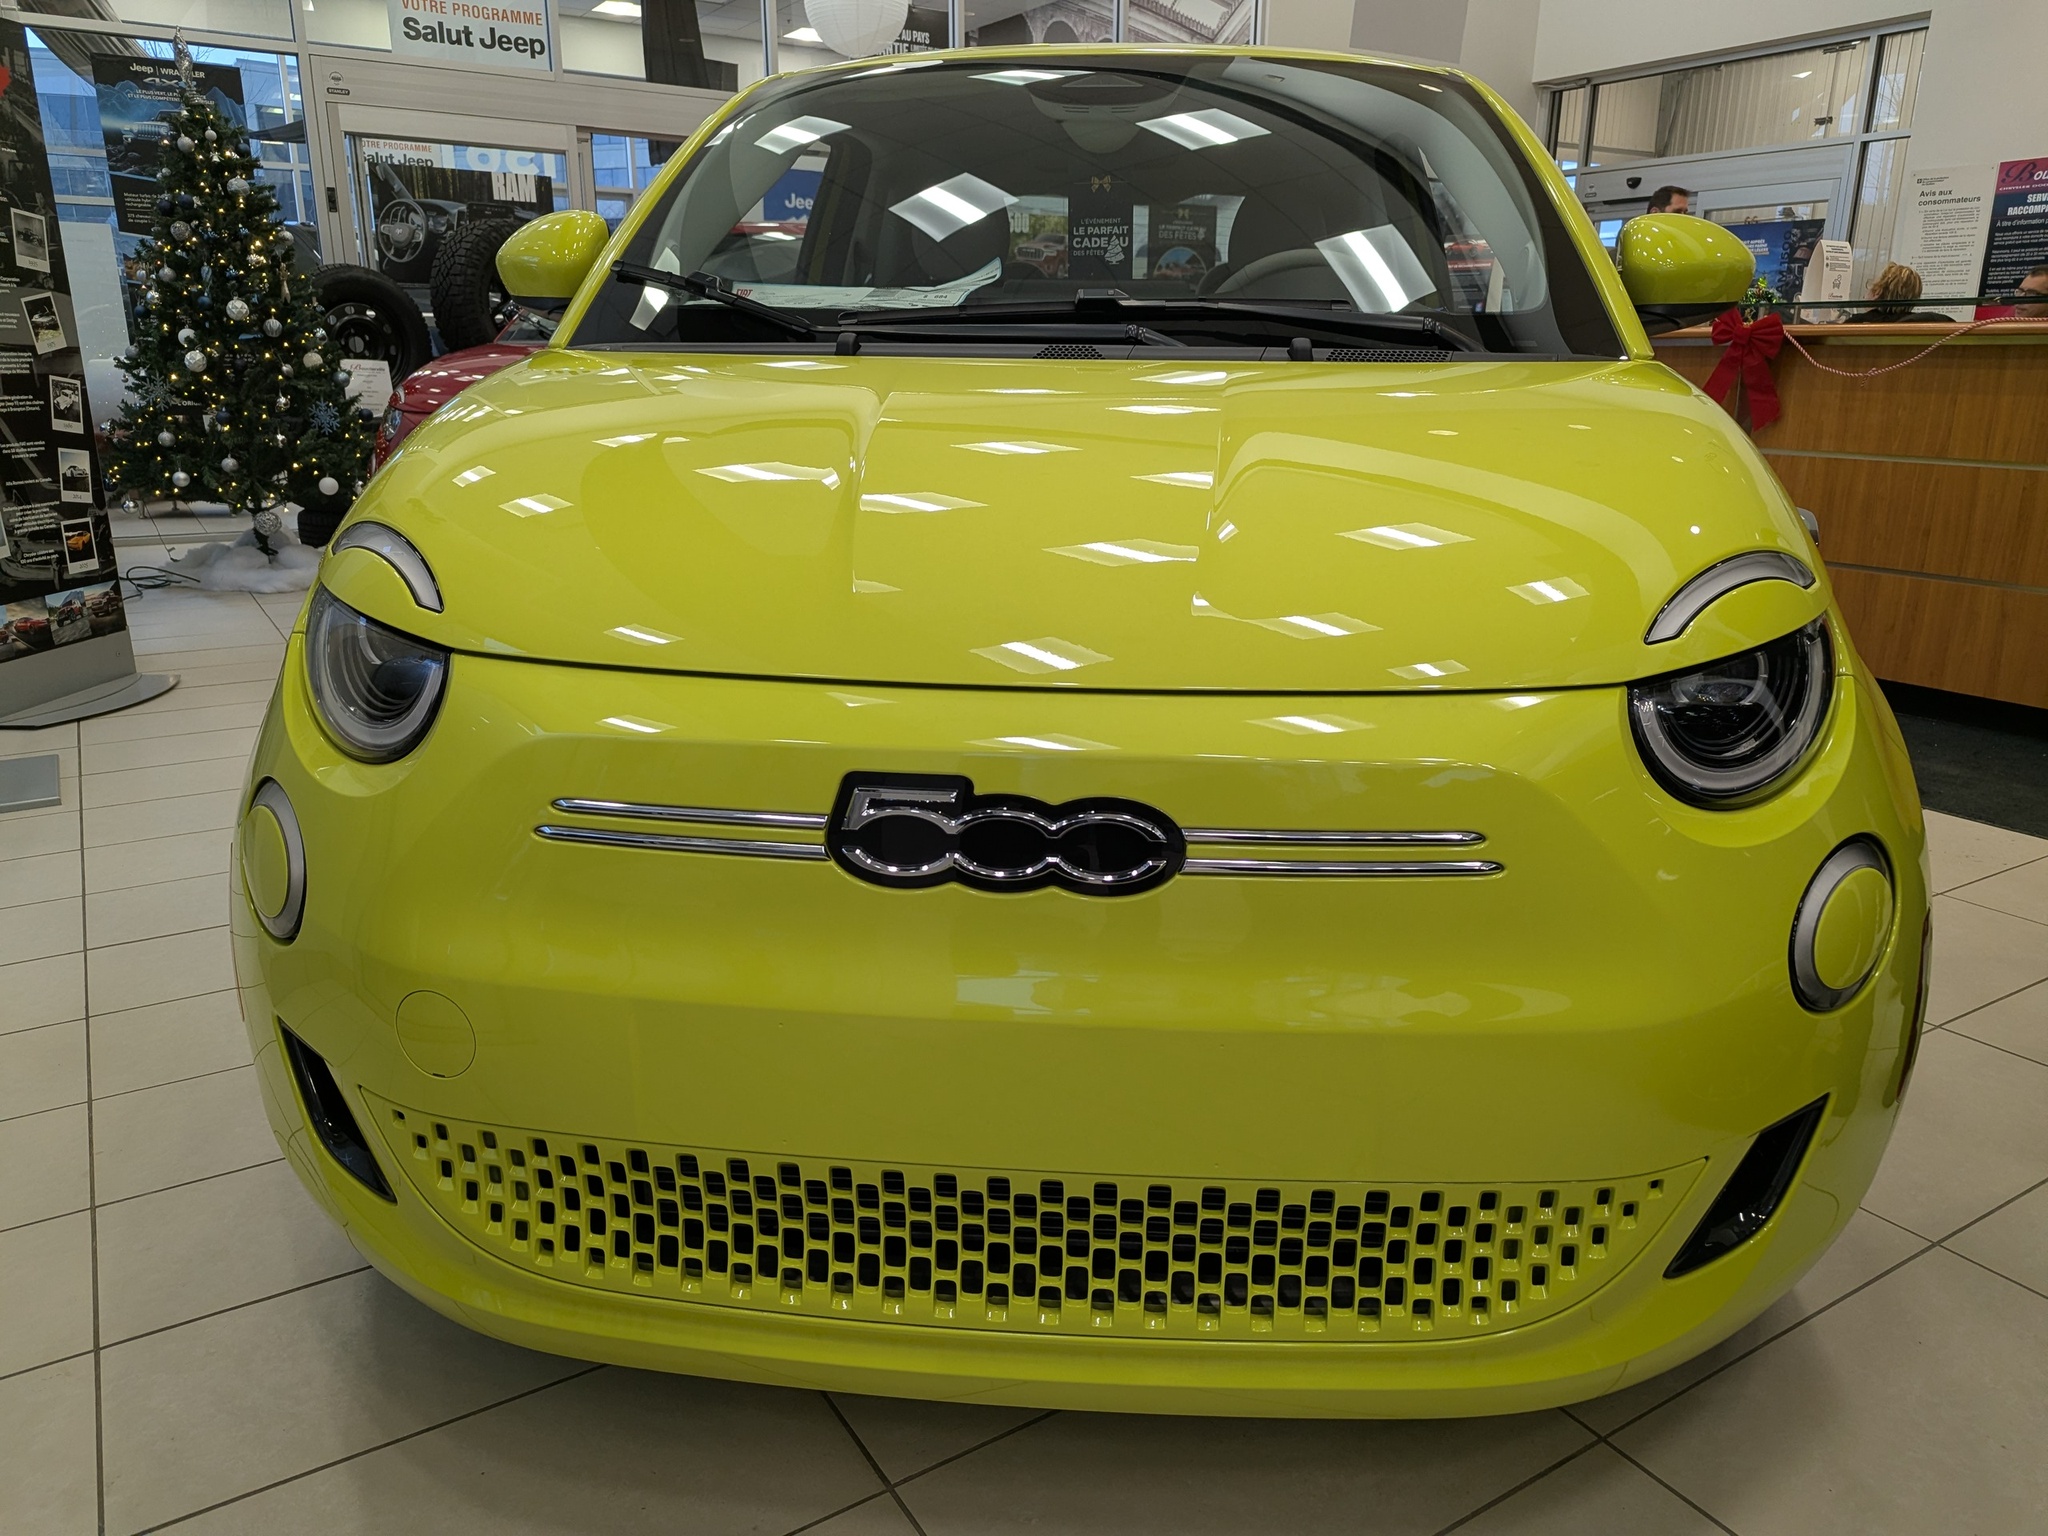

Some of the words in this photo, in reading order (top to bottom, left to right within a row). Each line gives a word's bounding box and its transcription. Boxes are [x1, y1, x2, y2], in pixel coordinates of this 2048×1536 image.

[452, 2, 543, 26] PROGRAMME
[402, 16, 474, 48] Salut
[479, 27, 545, 59] Jeep
[913, 30, 930, 44] PAYS
[130, 63, 154, 74] Jeep
[160, 67, 206, 79] WRALER
[383, 141, 432, 153] PROGRAMME
[397, 154, 434, 167] Jeep
[491, 171, 537, 203] RAM
[1919, 189, 1936, 198] Avis
[785, 193, 814, 211] Jee
[1917, 195, 1981, 207] consommateurs
[1073, 226, 1085, 235] LE
[1087, 225, 1129, 235] PARFAIT
[736, 288, 754, 298] FIAT
[841, 786, 1168, 886] 500
